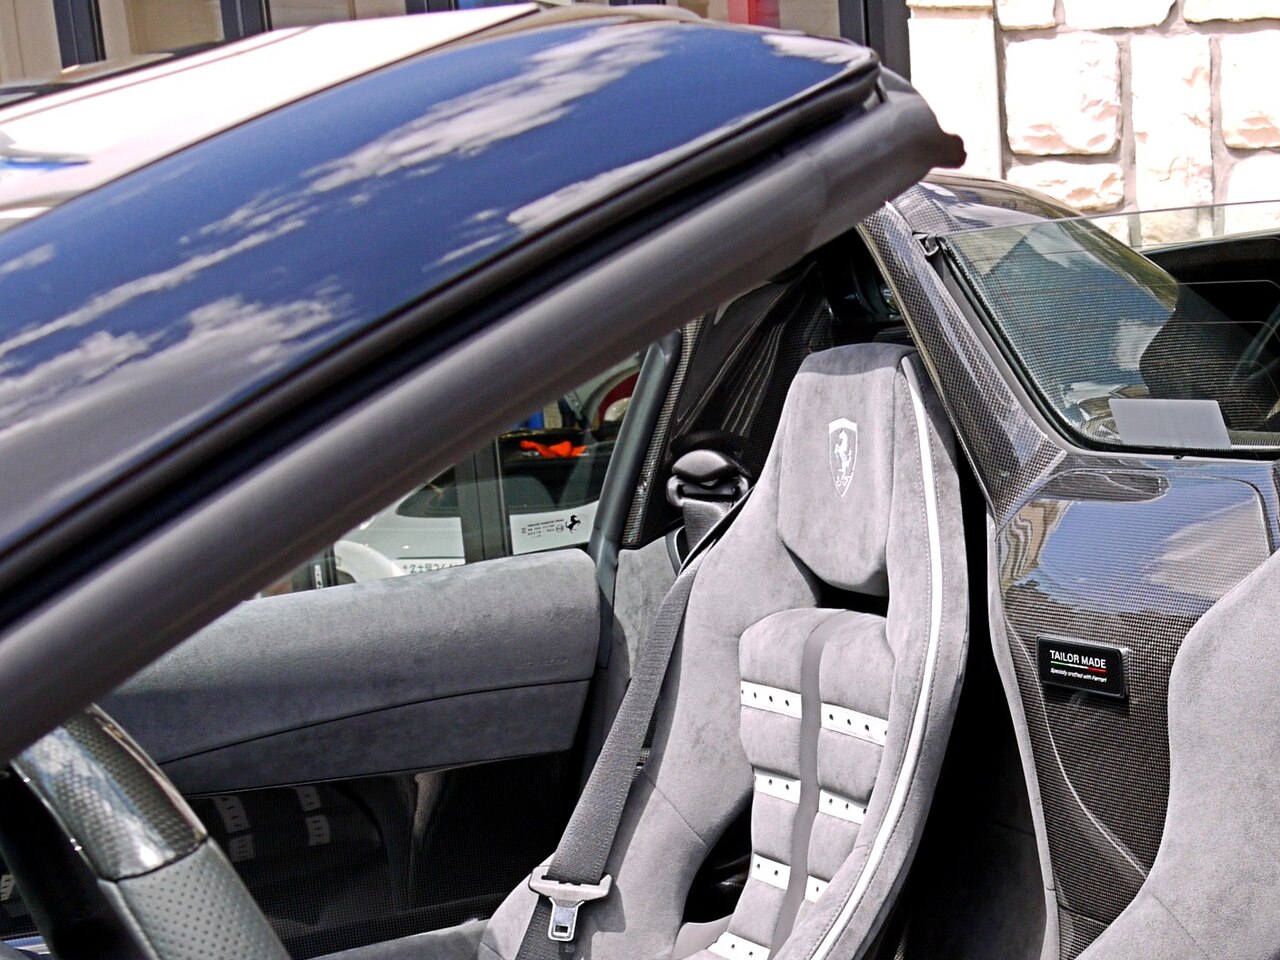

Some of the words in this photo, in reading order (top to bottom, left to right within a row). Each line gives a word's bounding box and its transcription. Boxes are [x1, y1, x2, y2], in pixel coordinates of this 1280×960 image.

[1049, 649, 1080, 664] TAILOR
[1081, 655, 1107, 669] MADE
[1092, 675, 1107, 683] Ferrari
